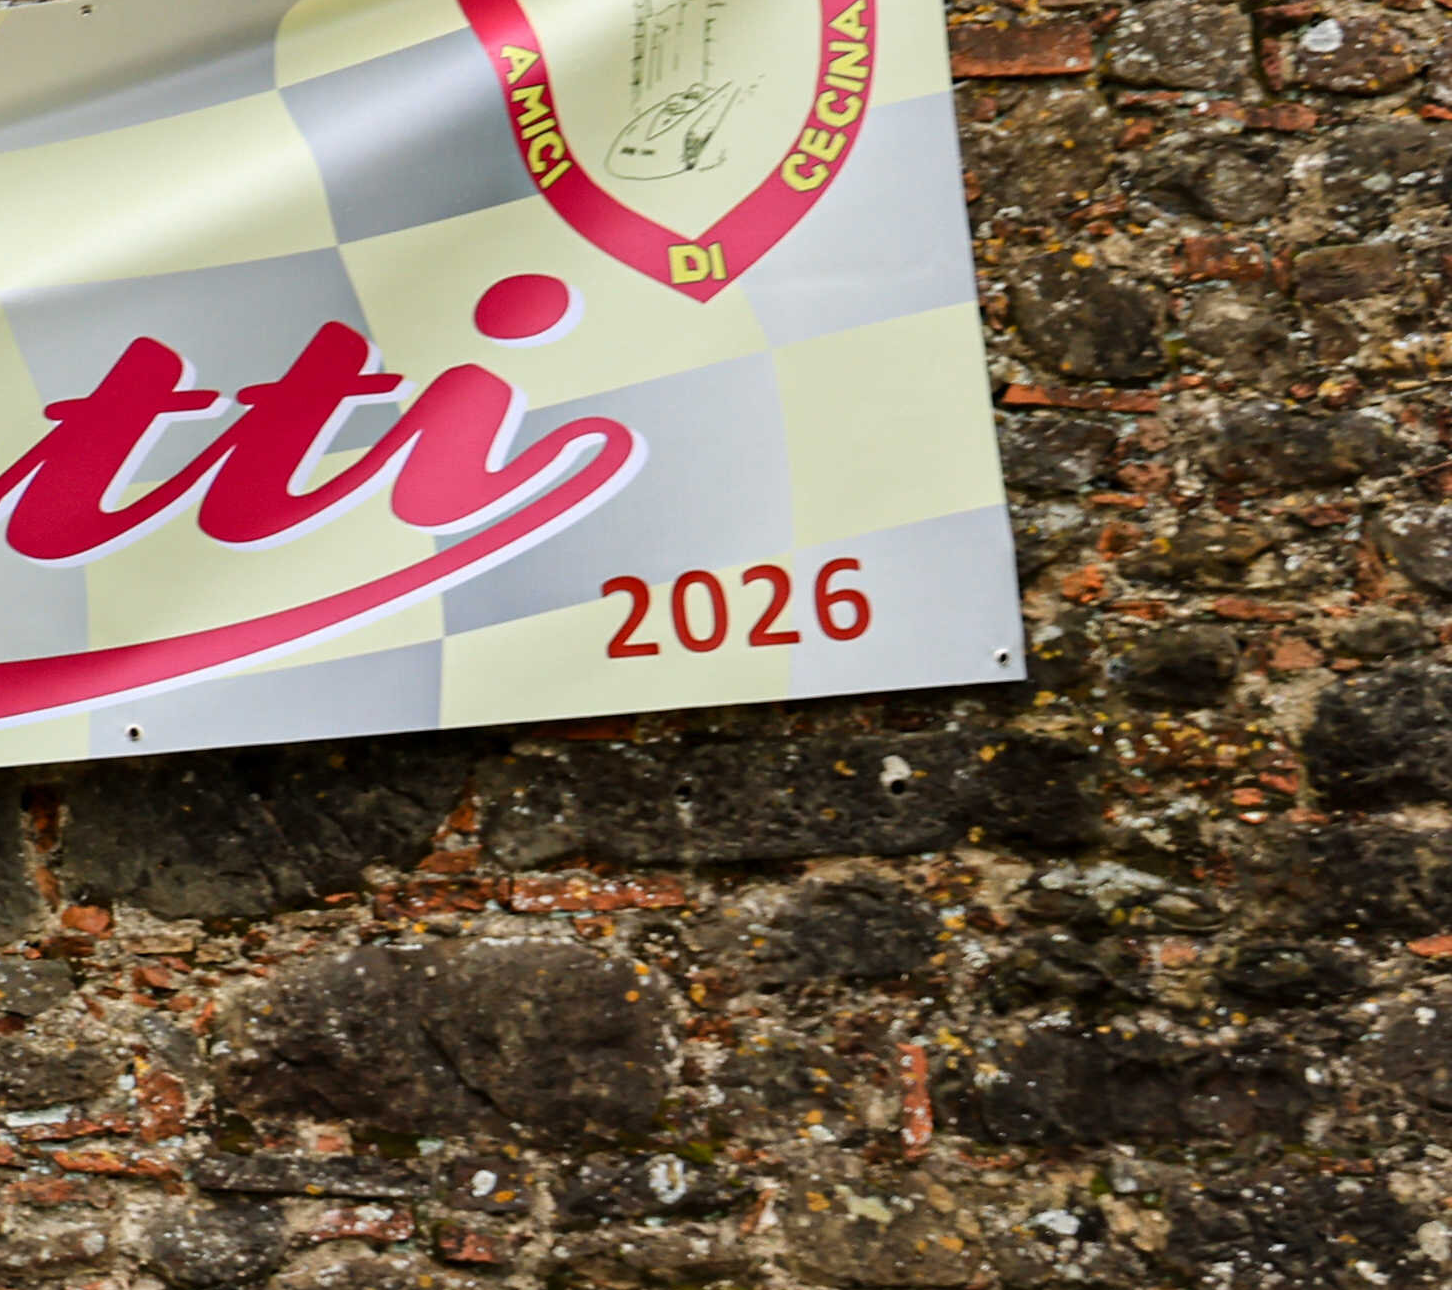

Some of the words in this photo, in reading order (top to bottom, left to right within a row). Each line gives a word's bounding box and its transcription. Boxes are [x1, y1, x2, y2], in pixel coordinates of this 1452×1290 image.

[500, 44, 574, 189] AMICI
[667, 241, 728, 285] DI
[600, 557, 871, 659] 2026
